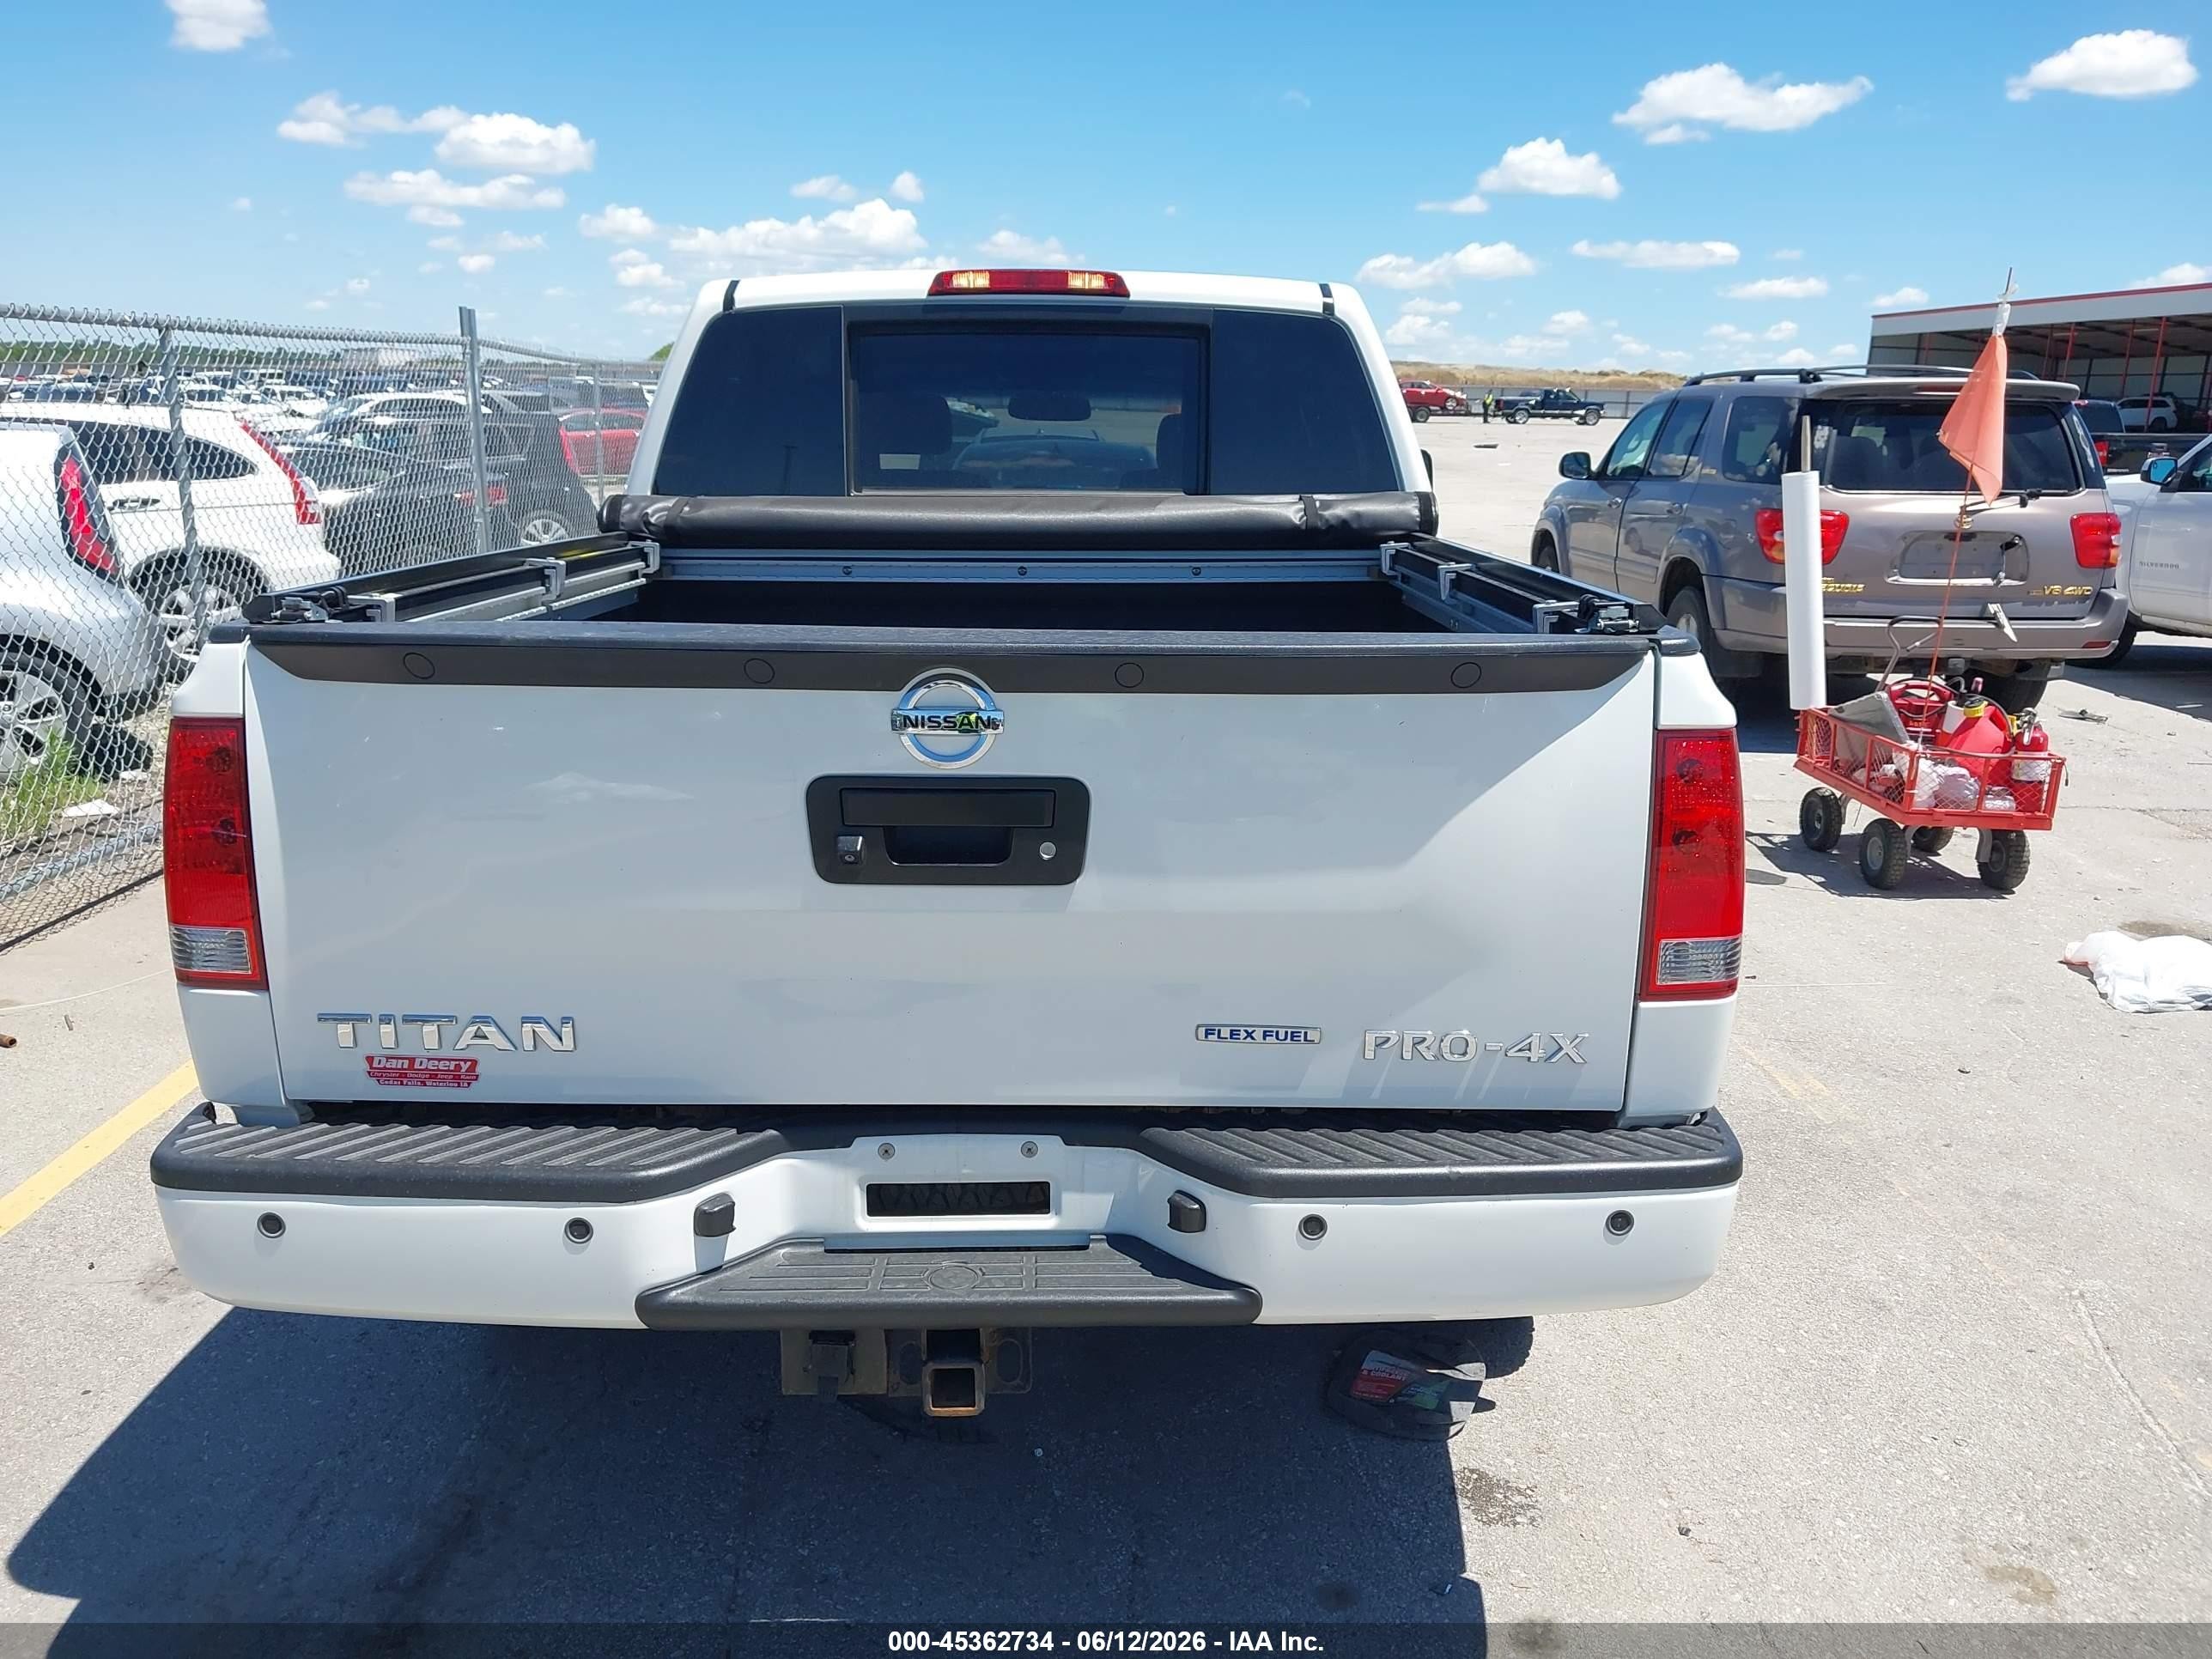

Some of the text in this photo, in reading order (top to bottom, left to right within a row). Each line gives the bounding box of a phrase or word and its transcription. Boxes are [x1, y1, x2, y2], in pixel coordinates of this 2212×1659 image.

[2063, 586, 2094, 596] 4WD
[902, 714, 991, 730] NISSAN
[317, 1012, 576, 1052] TITAN
[1204, 1028, 1316, 1042] FLEX FUEL
[1364, 1030, 1589, 1064] PRO-4X
[372, 1056, 472, 1073] Dan Deery
